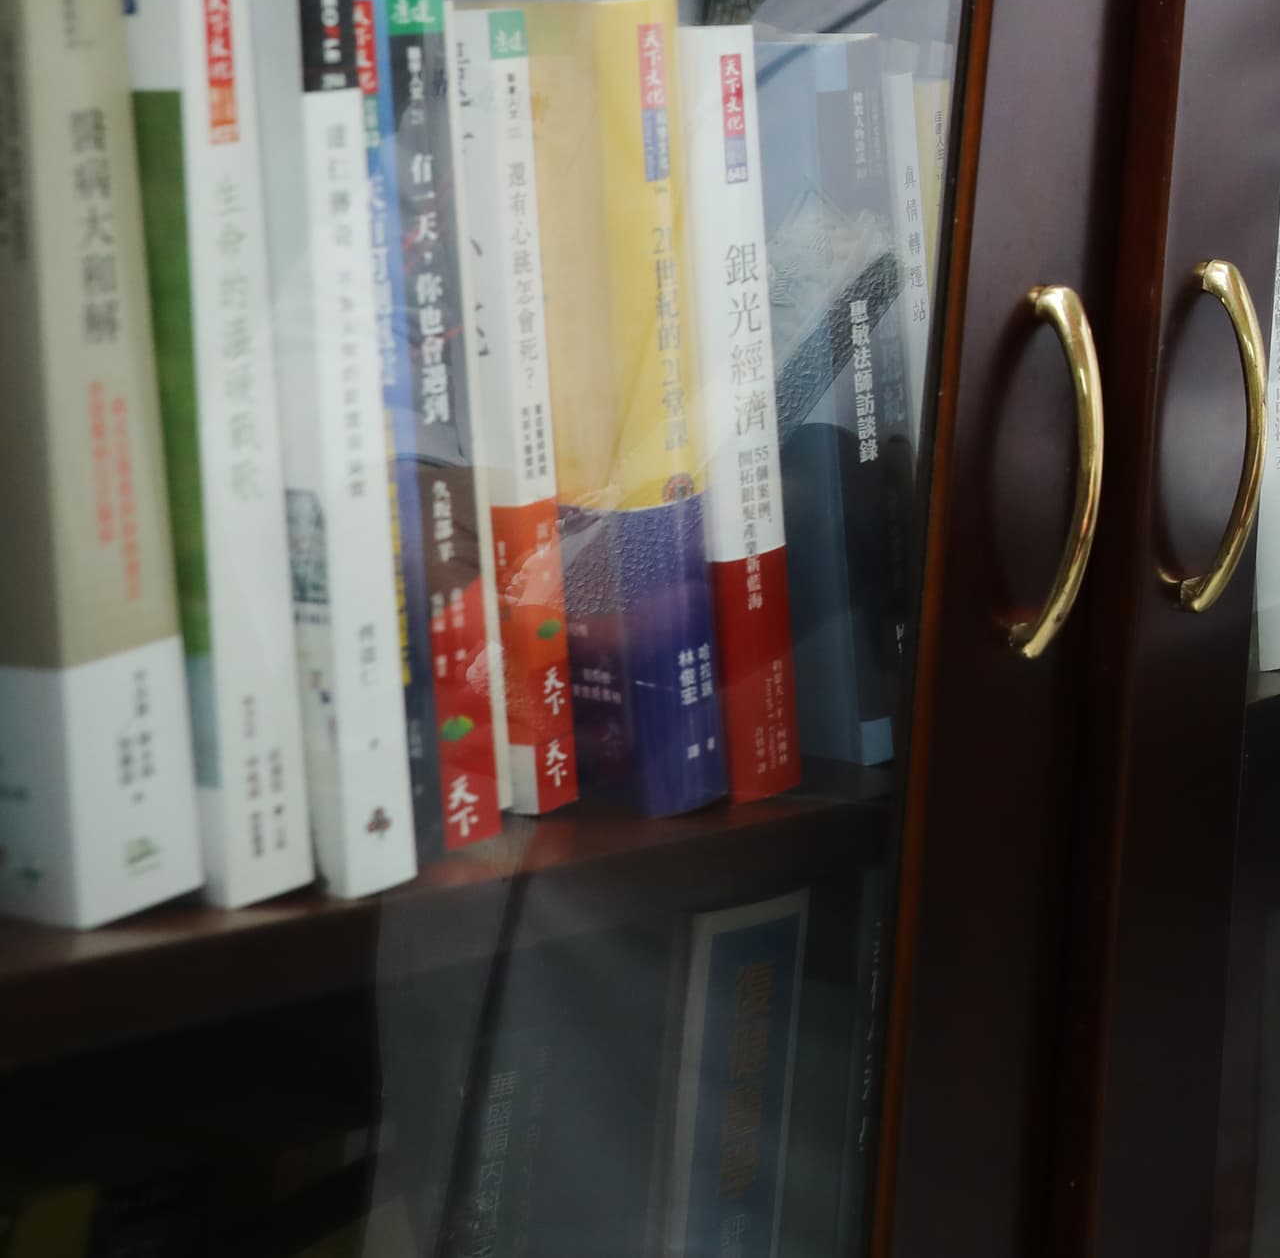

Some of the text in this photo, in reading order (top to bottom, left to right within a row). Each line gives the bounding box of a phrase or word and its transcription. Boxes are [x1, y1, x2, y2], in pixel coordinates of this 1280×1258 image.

[643, 29, 665, 106] 天下文化
[724, 59, 744, 131] 天下文化
[723, 242, 768, 437] 銀光經濟
[849, 300, 880, 464] 惠敏法師訪談錄
[543, 665, 568, 716] 天下
[545, 737, 570, 788] 天下
[447, 772, 480, 839] 天下
